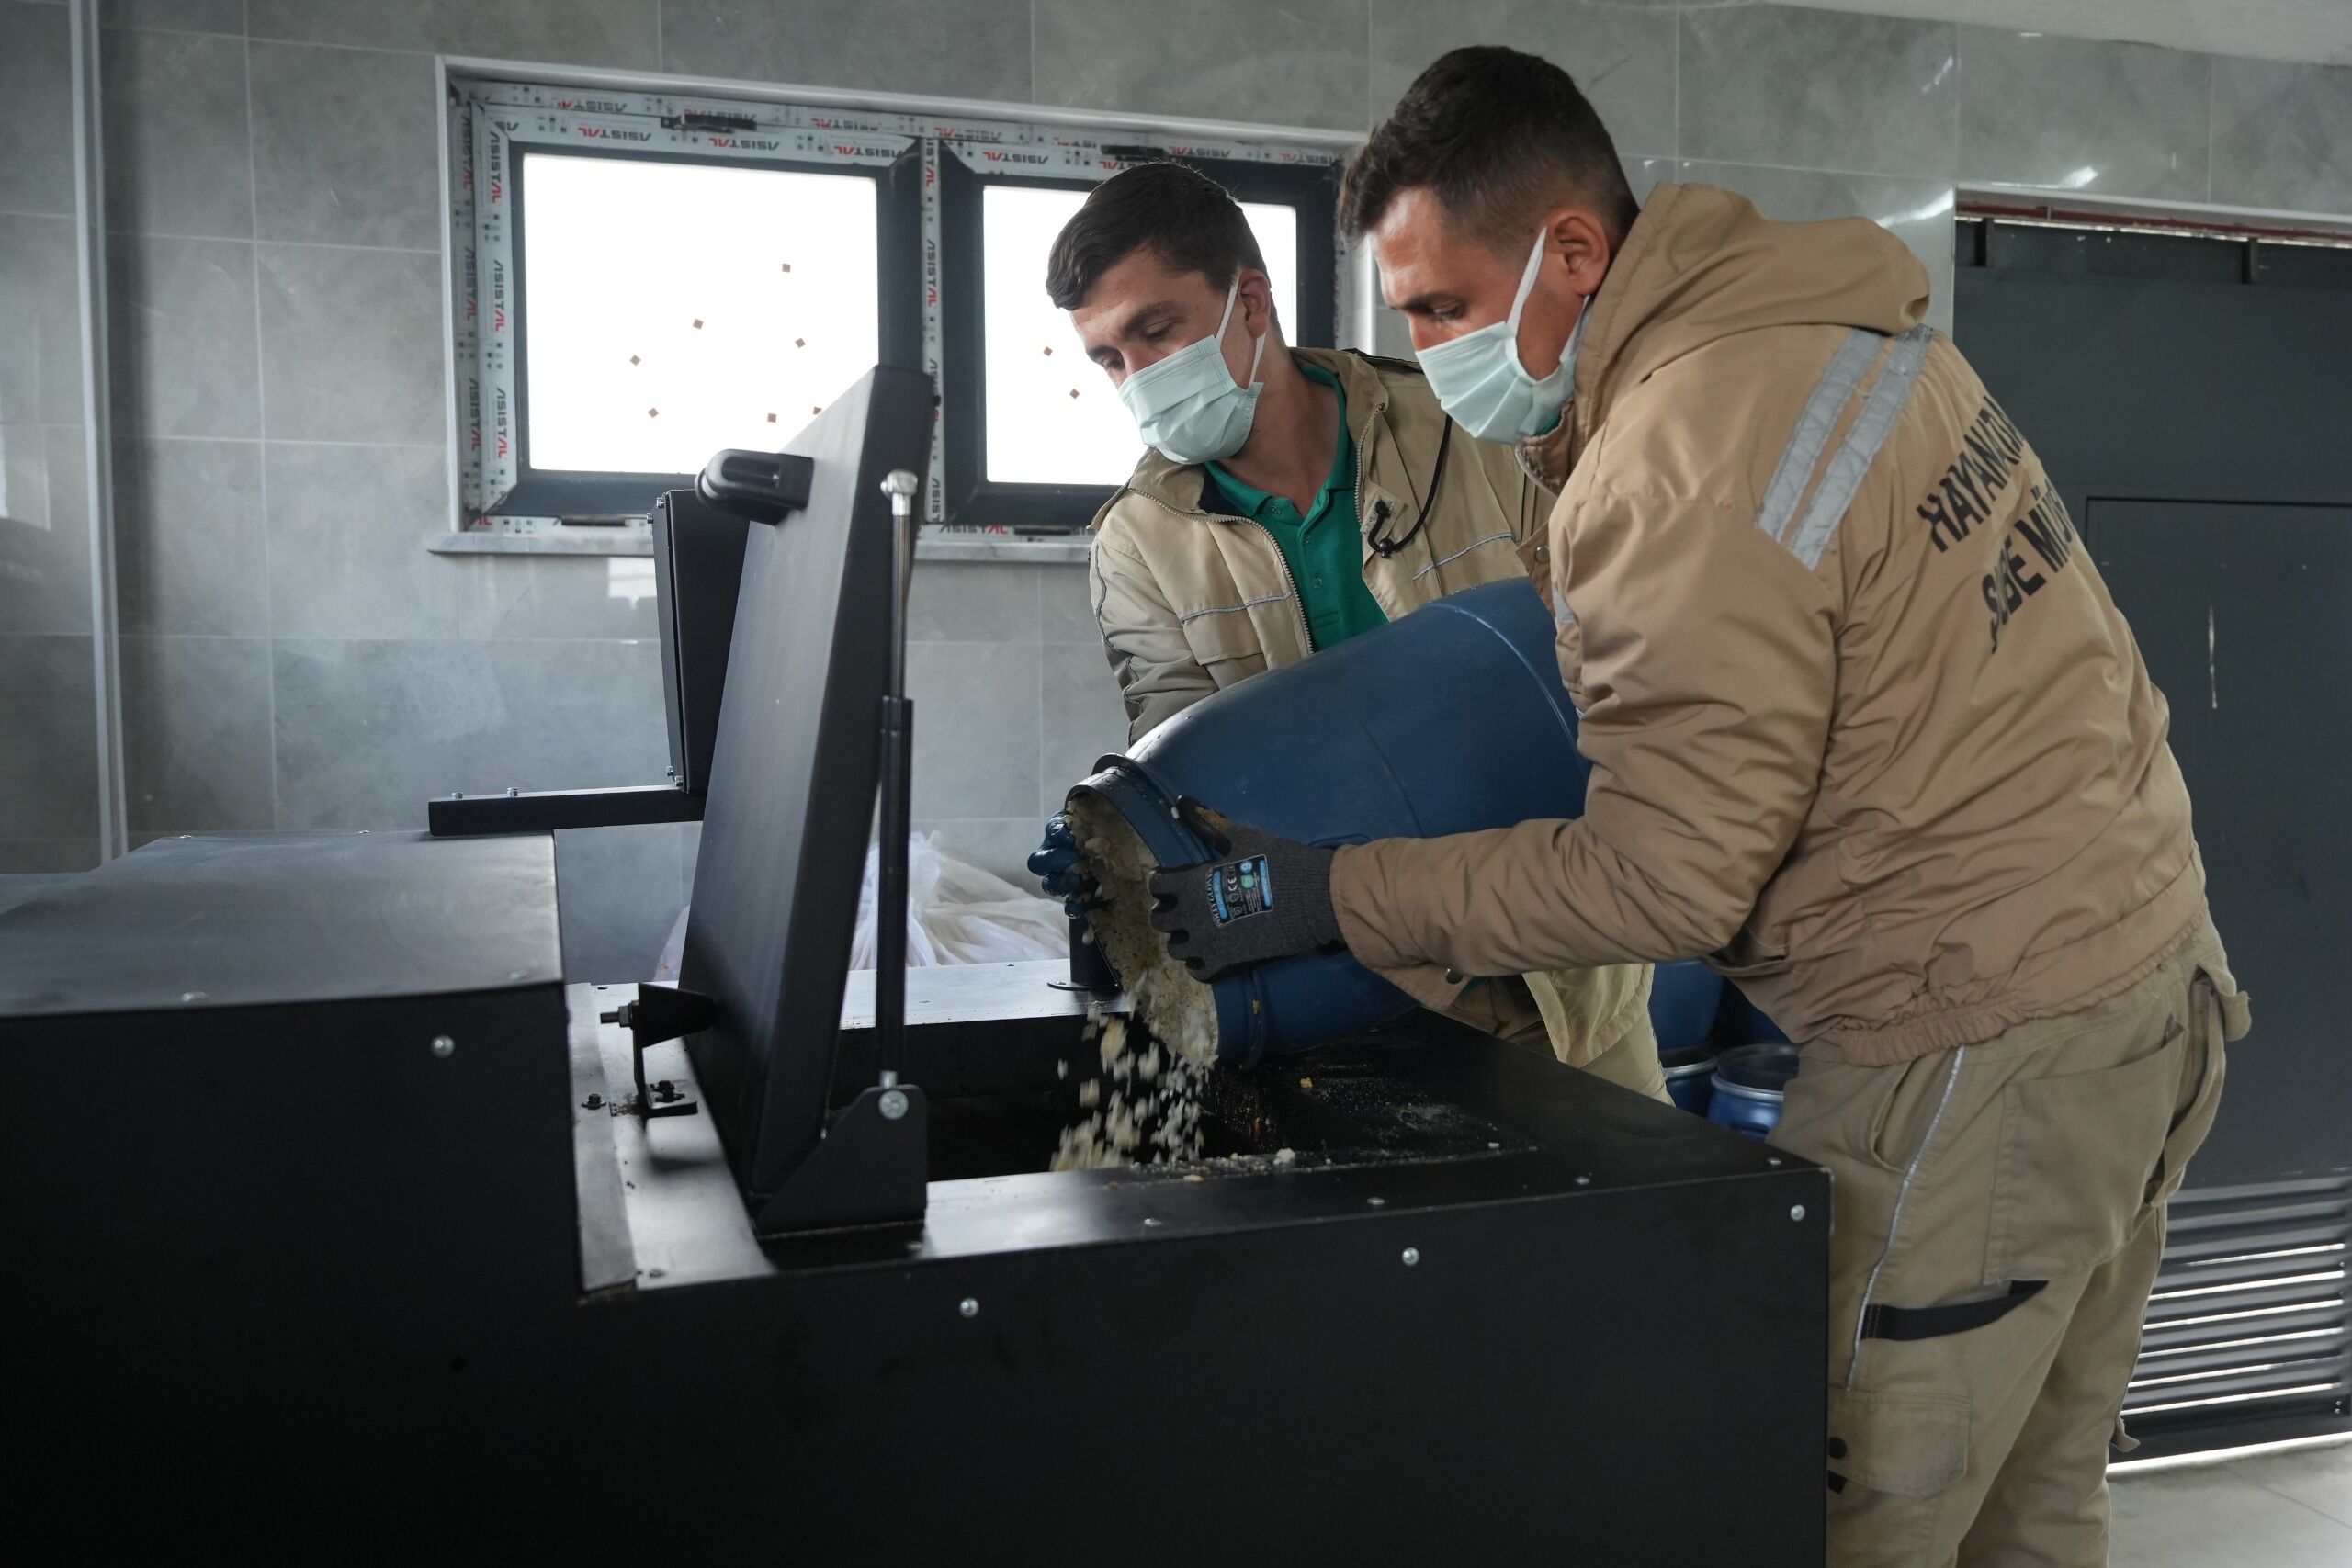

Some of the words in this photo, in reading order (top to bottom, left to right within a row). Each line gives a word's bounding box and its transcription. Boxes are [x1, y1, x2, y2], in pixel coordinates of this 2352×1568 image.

[578, 127, 652, 141] ASISTAL
[709, 137, 779, 150] ASISTAL
[1169, 146, 1231, 158] ASISTAL
[491, 130, 502, 204] ASISTAL
[983, 151, 1048, 164] ASISTAL
[927, 238, 937, 308] ASISTAL
[494, 259, 505, 332] ASISTAL
[497, 387, 508, 458] ASISTAL
